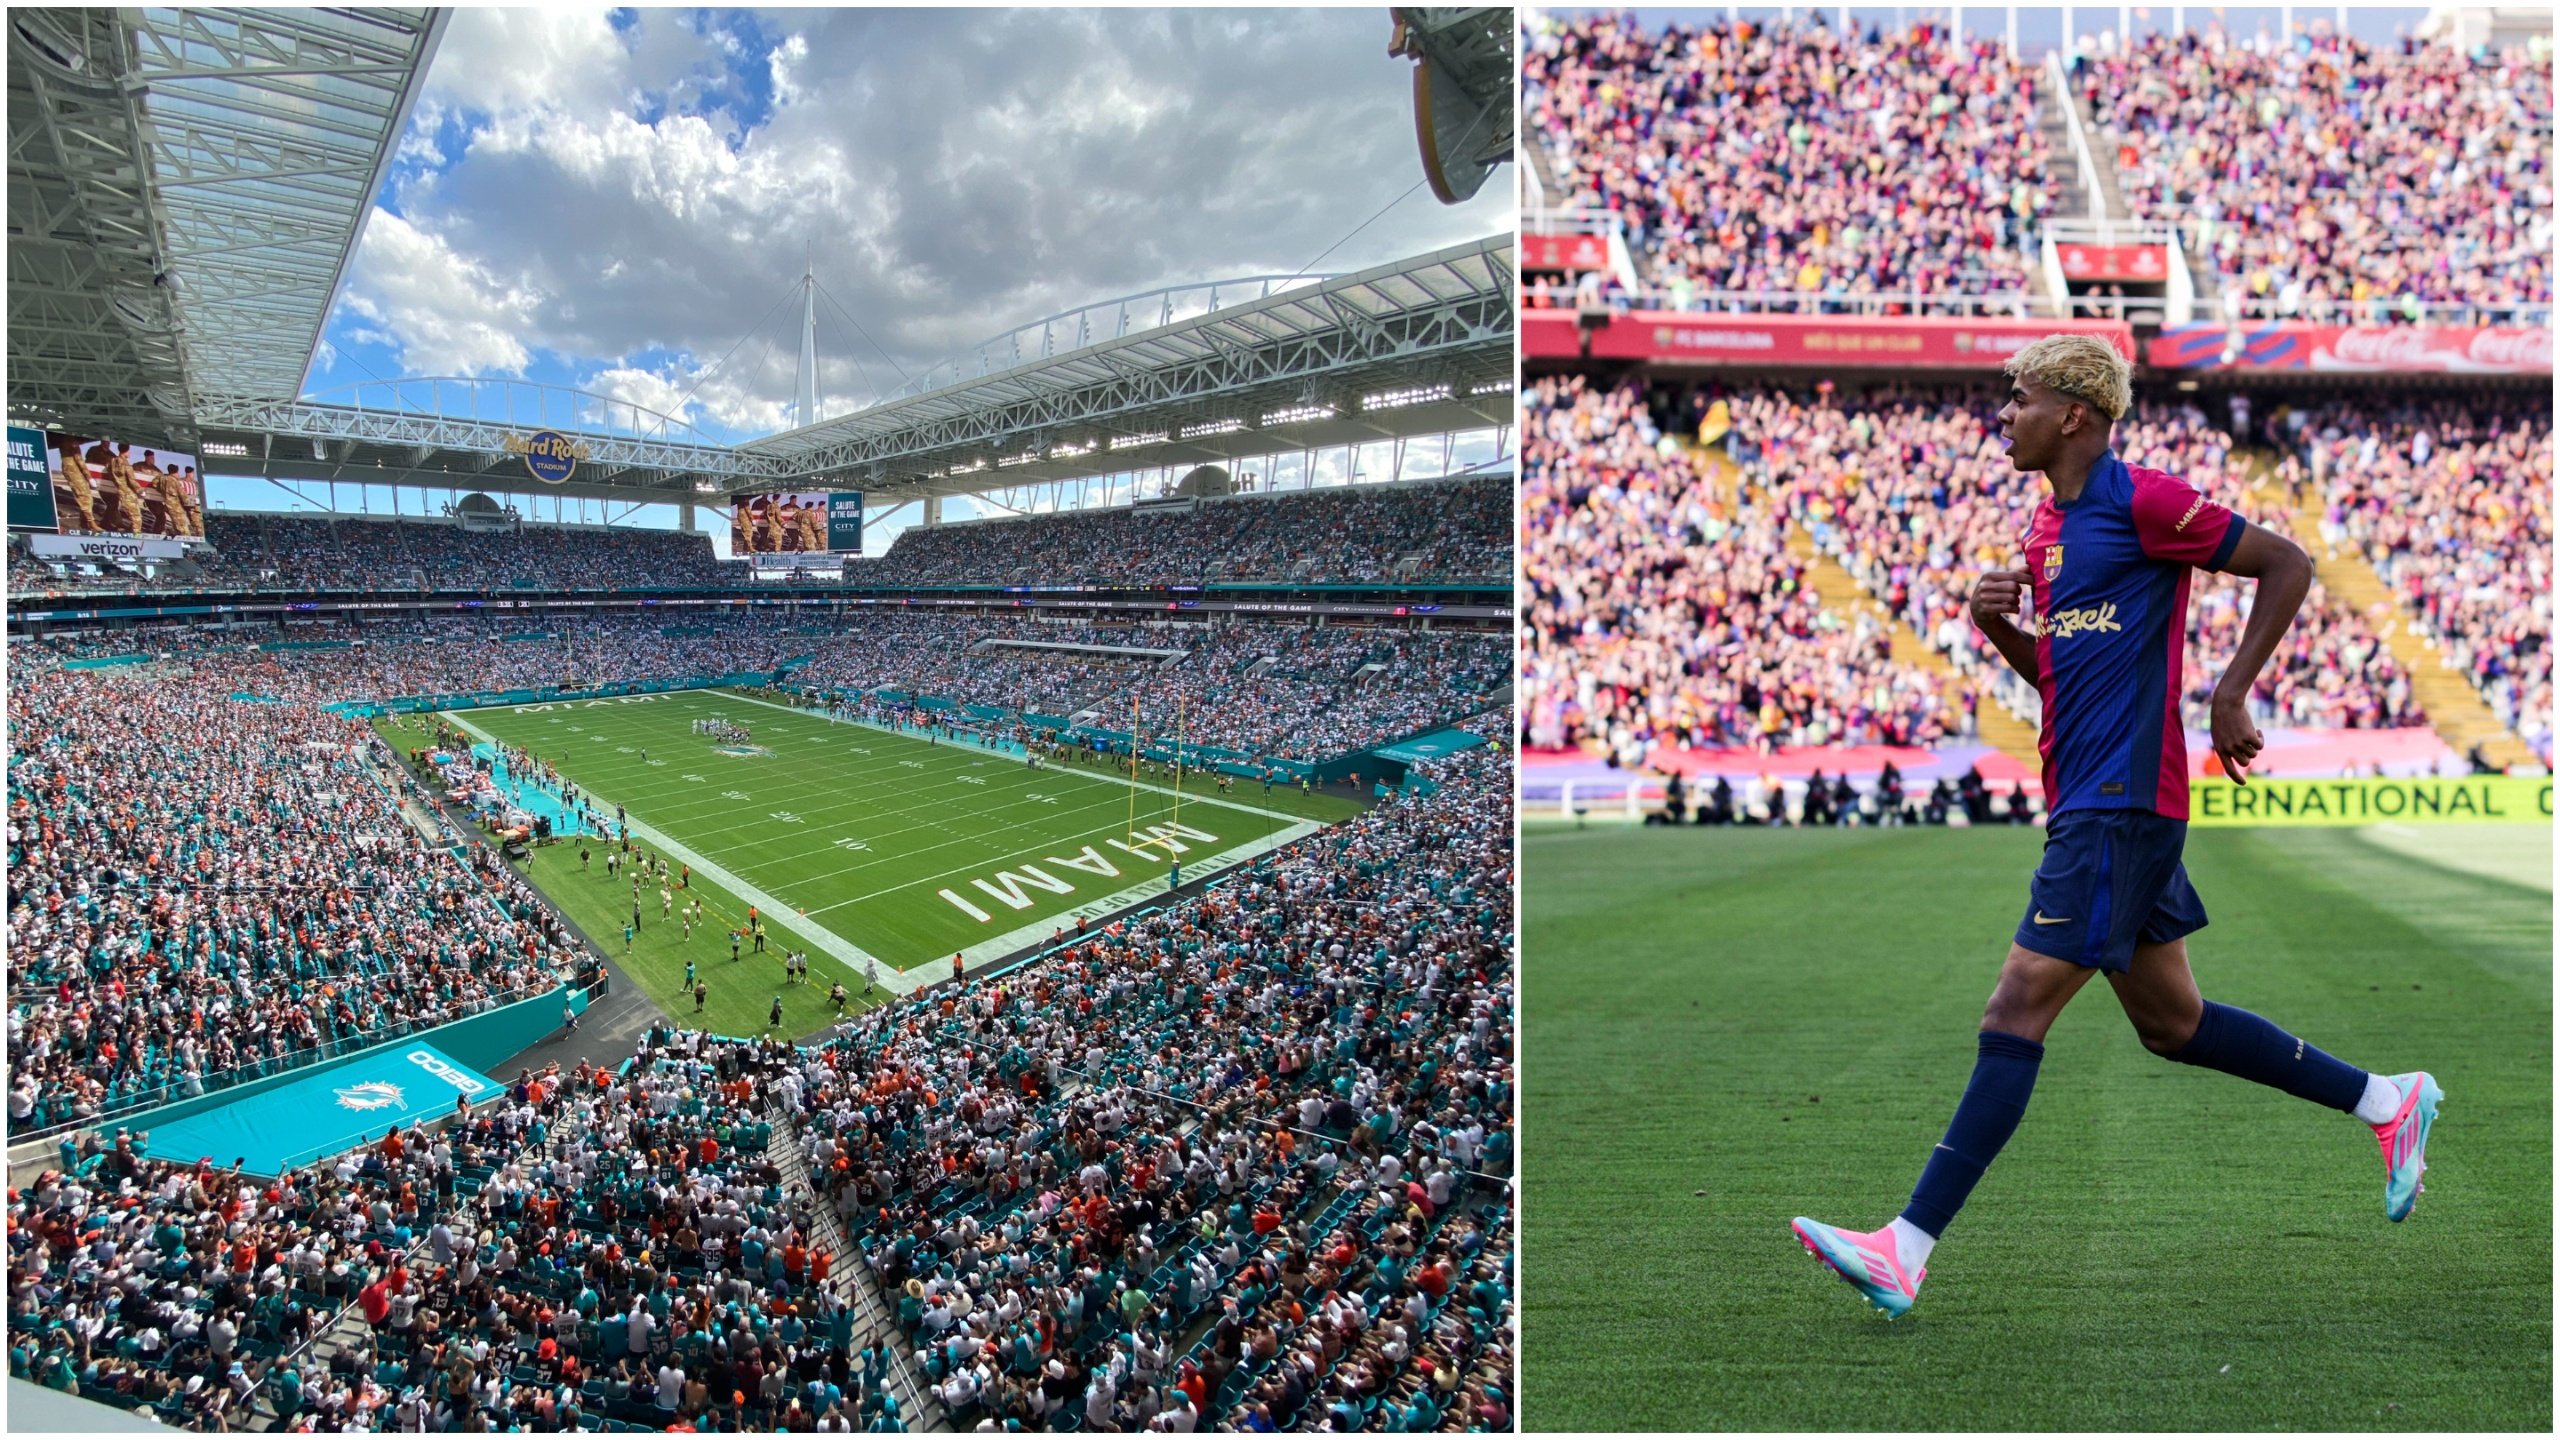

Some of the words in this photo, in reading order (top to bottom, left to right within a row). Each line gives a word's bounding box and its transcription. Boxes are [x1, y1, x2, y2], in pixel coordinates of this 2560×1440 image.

[505, 433, 550, 455] Hard
[551, 438, 590, 463] Rock
[22, 459, 46, 473] GAME
[536, 462, 566, 471] STADIUM
[836, 501, 855, 510] SALUTE
[844, 510, 859, 518] GAME
[80, 541, 139, 556] verizon
[514, 694, 672, 714] MIAMI
[832, 837, 867, 850] 10
[938, 820, 1219, 922] MIAMI
[407, 1050, 486, 1094] GEICO
[600, 1160, 611, 1169] 25
[916, 1179, 931, 1193] 32
[706, 1249, 720, 1262] 95
